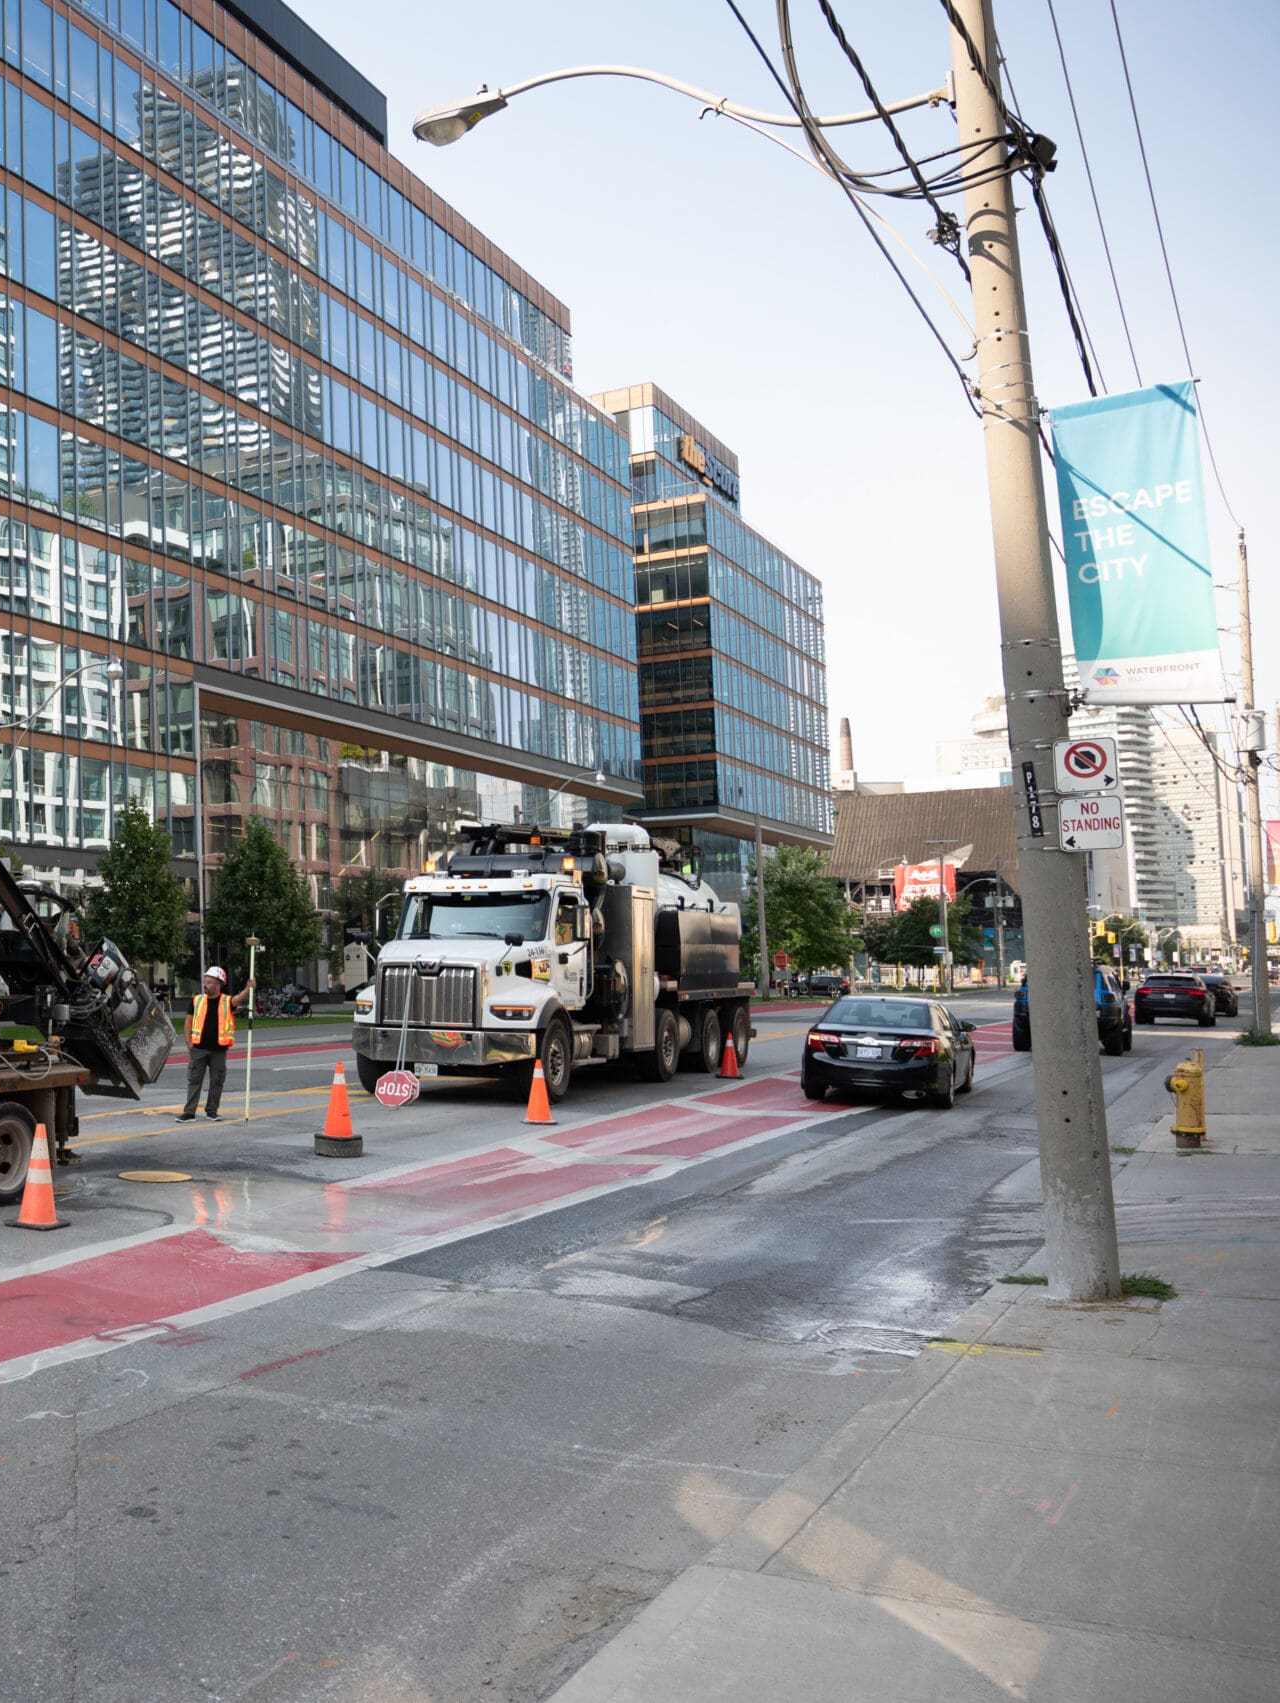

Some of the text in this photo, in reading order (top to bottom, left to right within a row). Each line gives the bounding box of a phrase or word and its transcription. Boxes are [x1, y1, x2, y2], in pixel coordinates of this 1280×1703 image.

[1072, 480, 1193, 520] ESCAPE
[1074, 524, 1135, 552] THE
[1078, 554, 1149, 584] CITY
[1126, 663, 1200, 675] WATERFRONT
[1080, 802, 1099, 815] NO
[1062, 817, 1120, 832] STANDING
[377, 1082, 410, 1097] STOP
